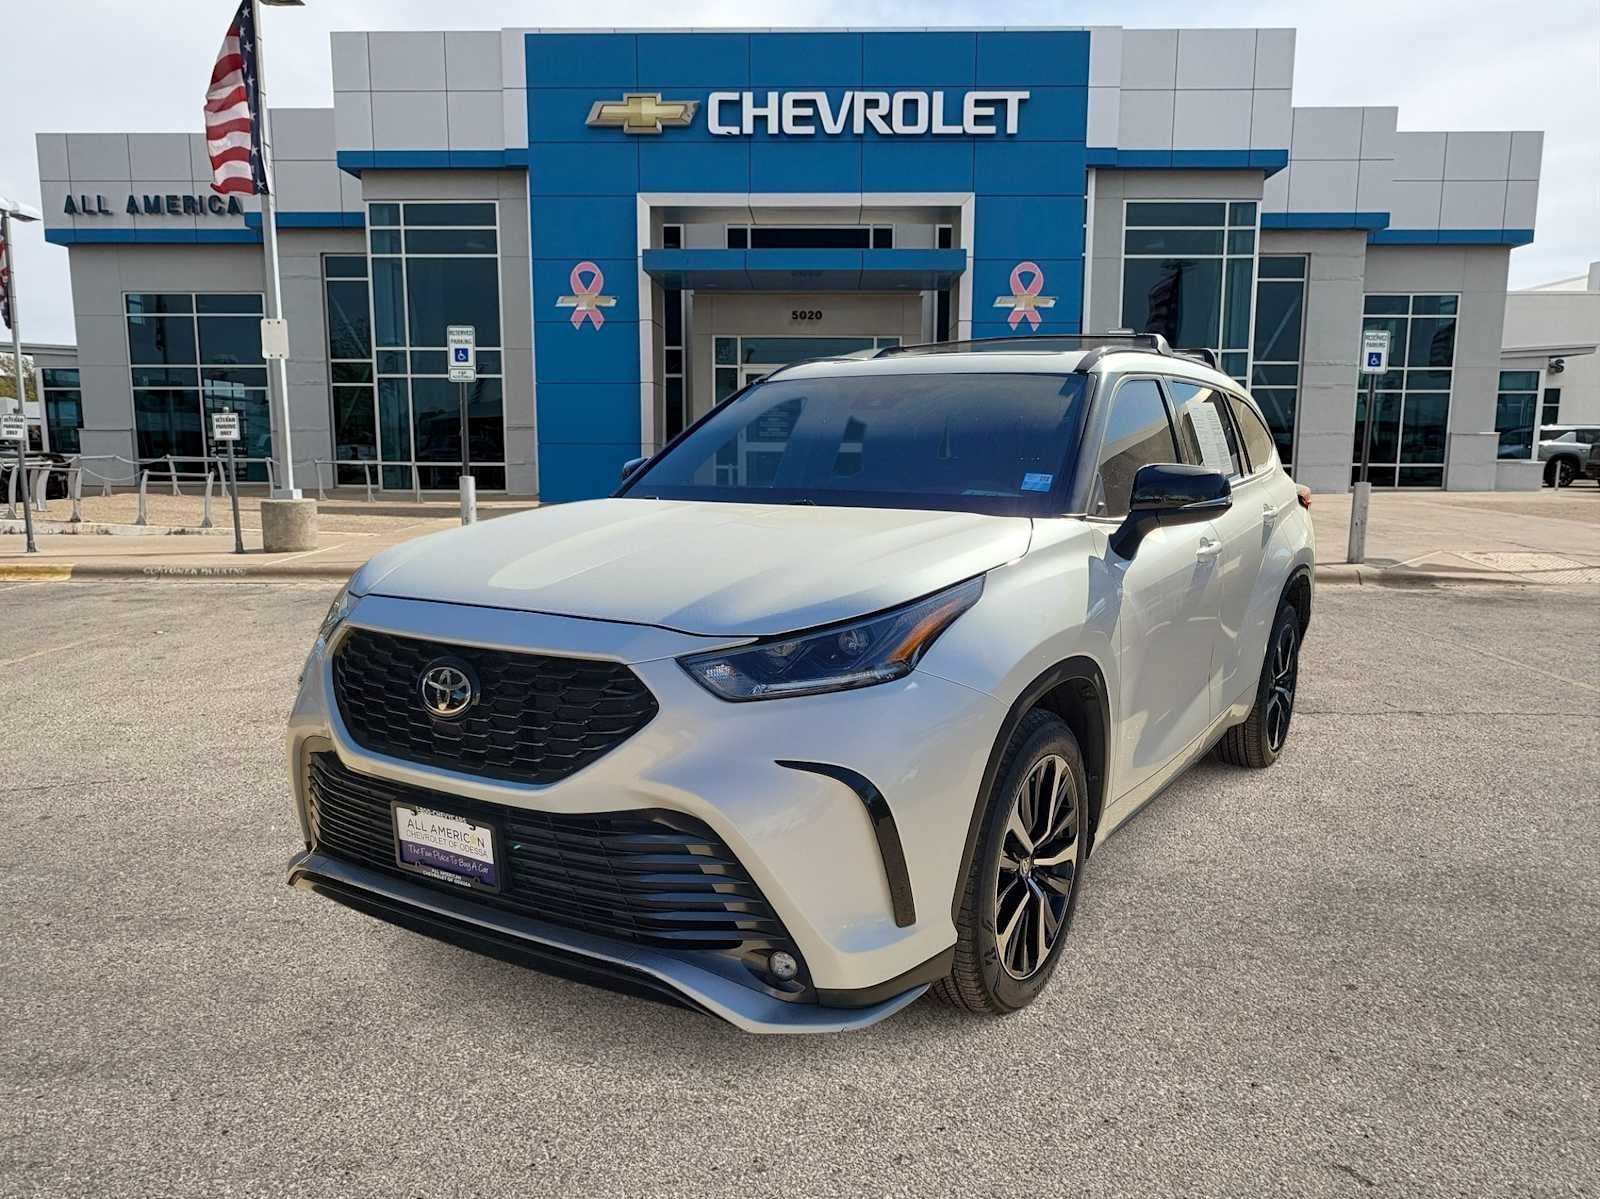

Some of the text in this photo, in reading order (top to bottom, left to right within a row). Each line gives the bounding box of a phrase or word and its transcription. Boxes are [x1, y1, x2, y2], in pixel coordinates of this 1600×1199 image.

[708, 91, 1030, 135] CHEVROLET
[64, 195, 243, 215] ALL AMERICA
[791, 310, 823, 320] 5020
[407, 818, 485, 848] ALL AMERICN
[407, 829, 488, 858] CHEVROLET OF ODESSA
[408, 844, 420, 855] The
